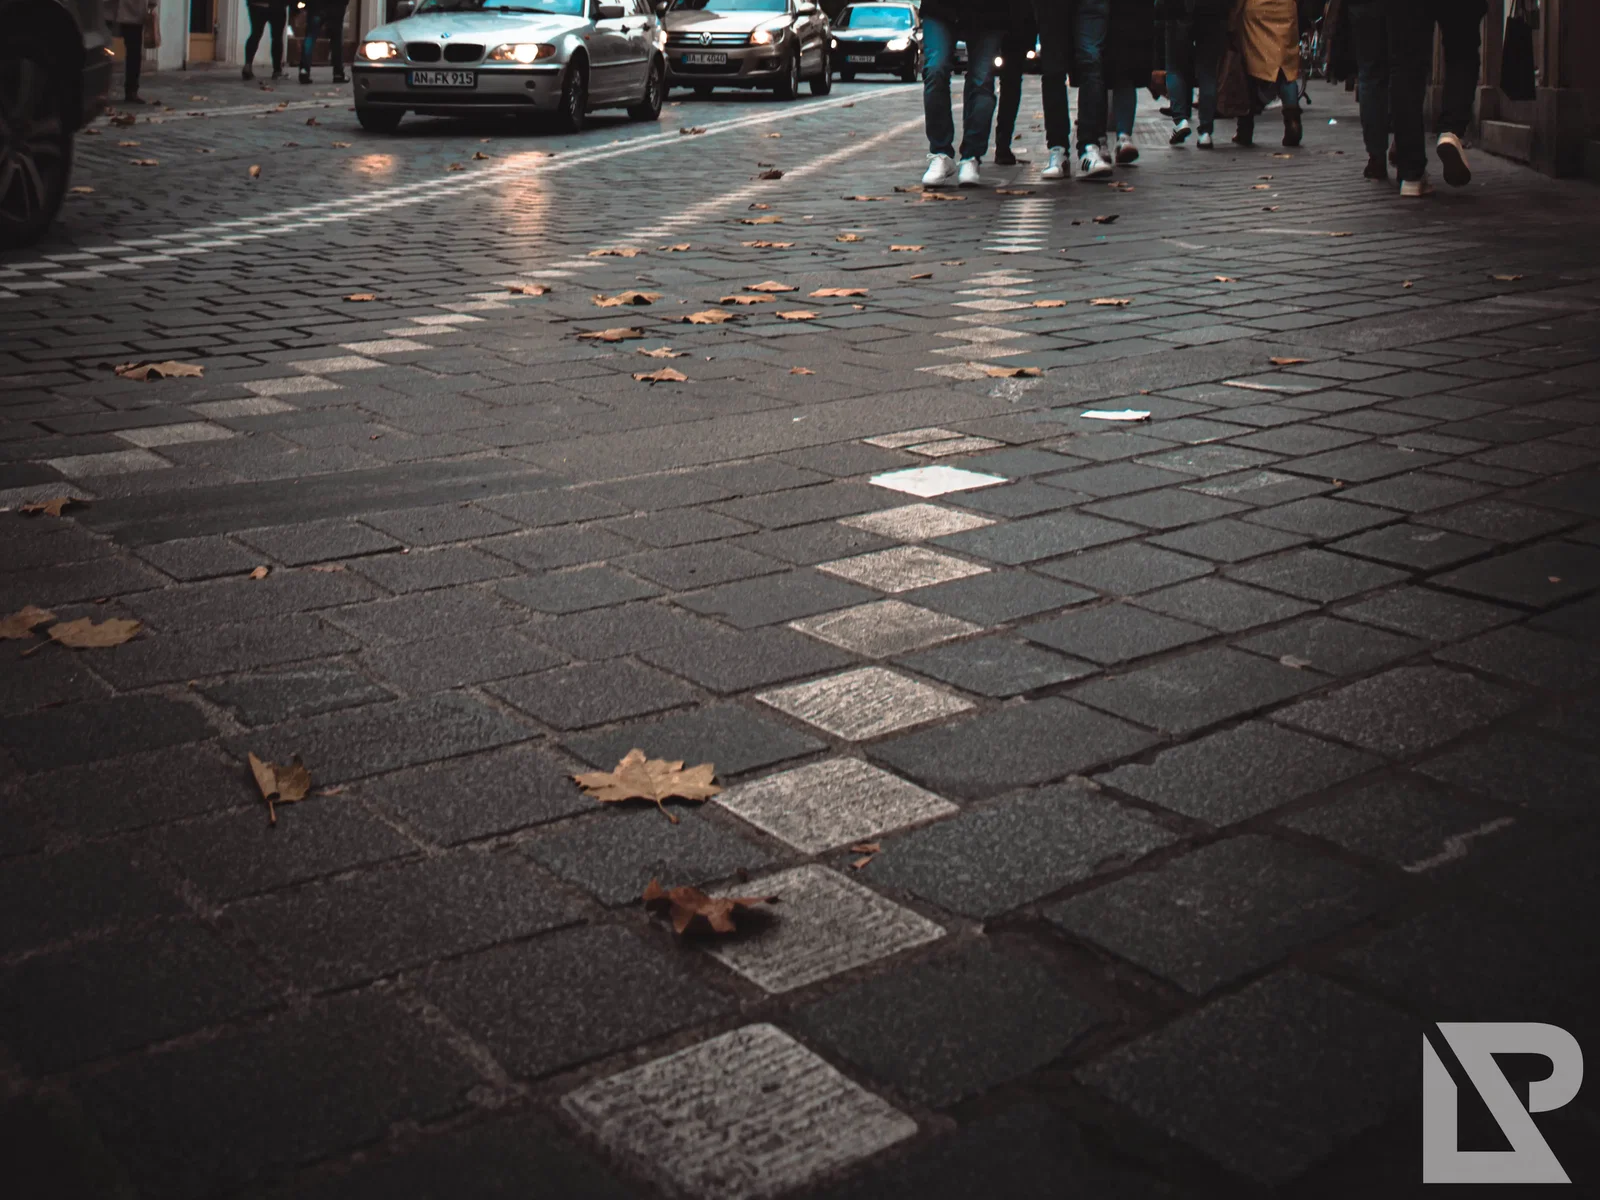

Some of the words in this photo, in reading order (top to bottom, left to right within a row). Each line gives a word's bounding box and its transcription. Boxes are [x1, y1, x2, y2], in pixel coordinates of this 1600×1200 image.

[414, 72, 428, 84] AN
[434, 72, 450, 85] FK
[452, 73, 473, 85] 915
